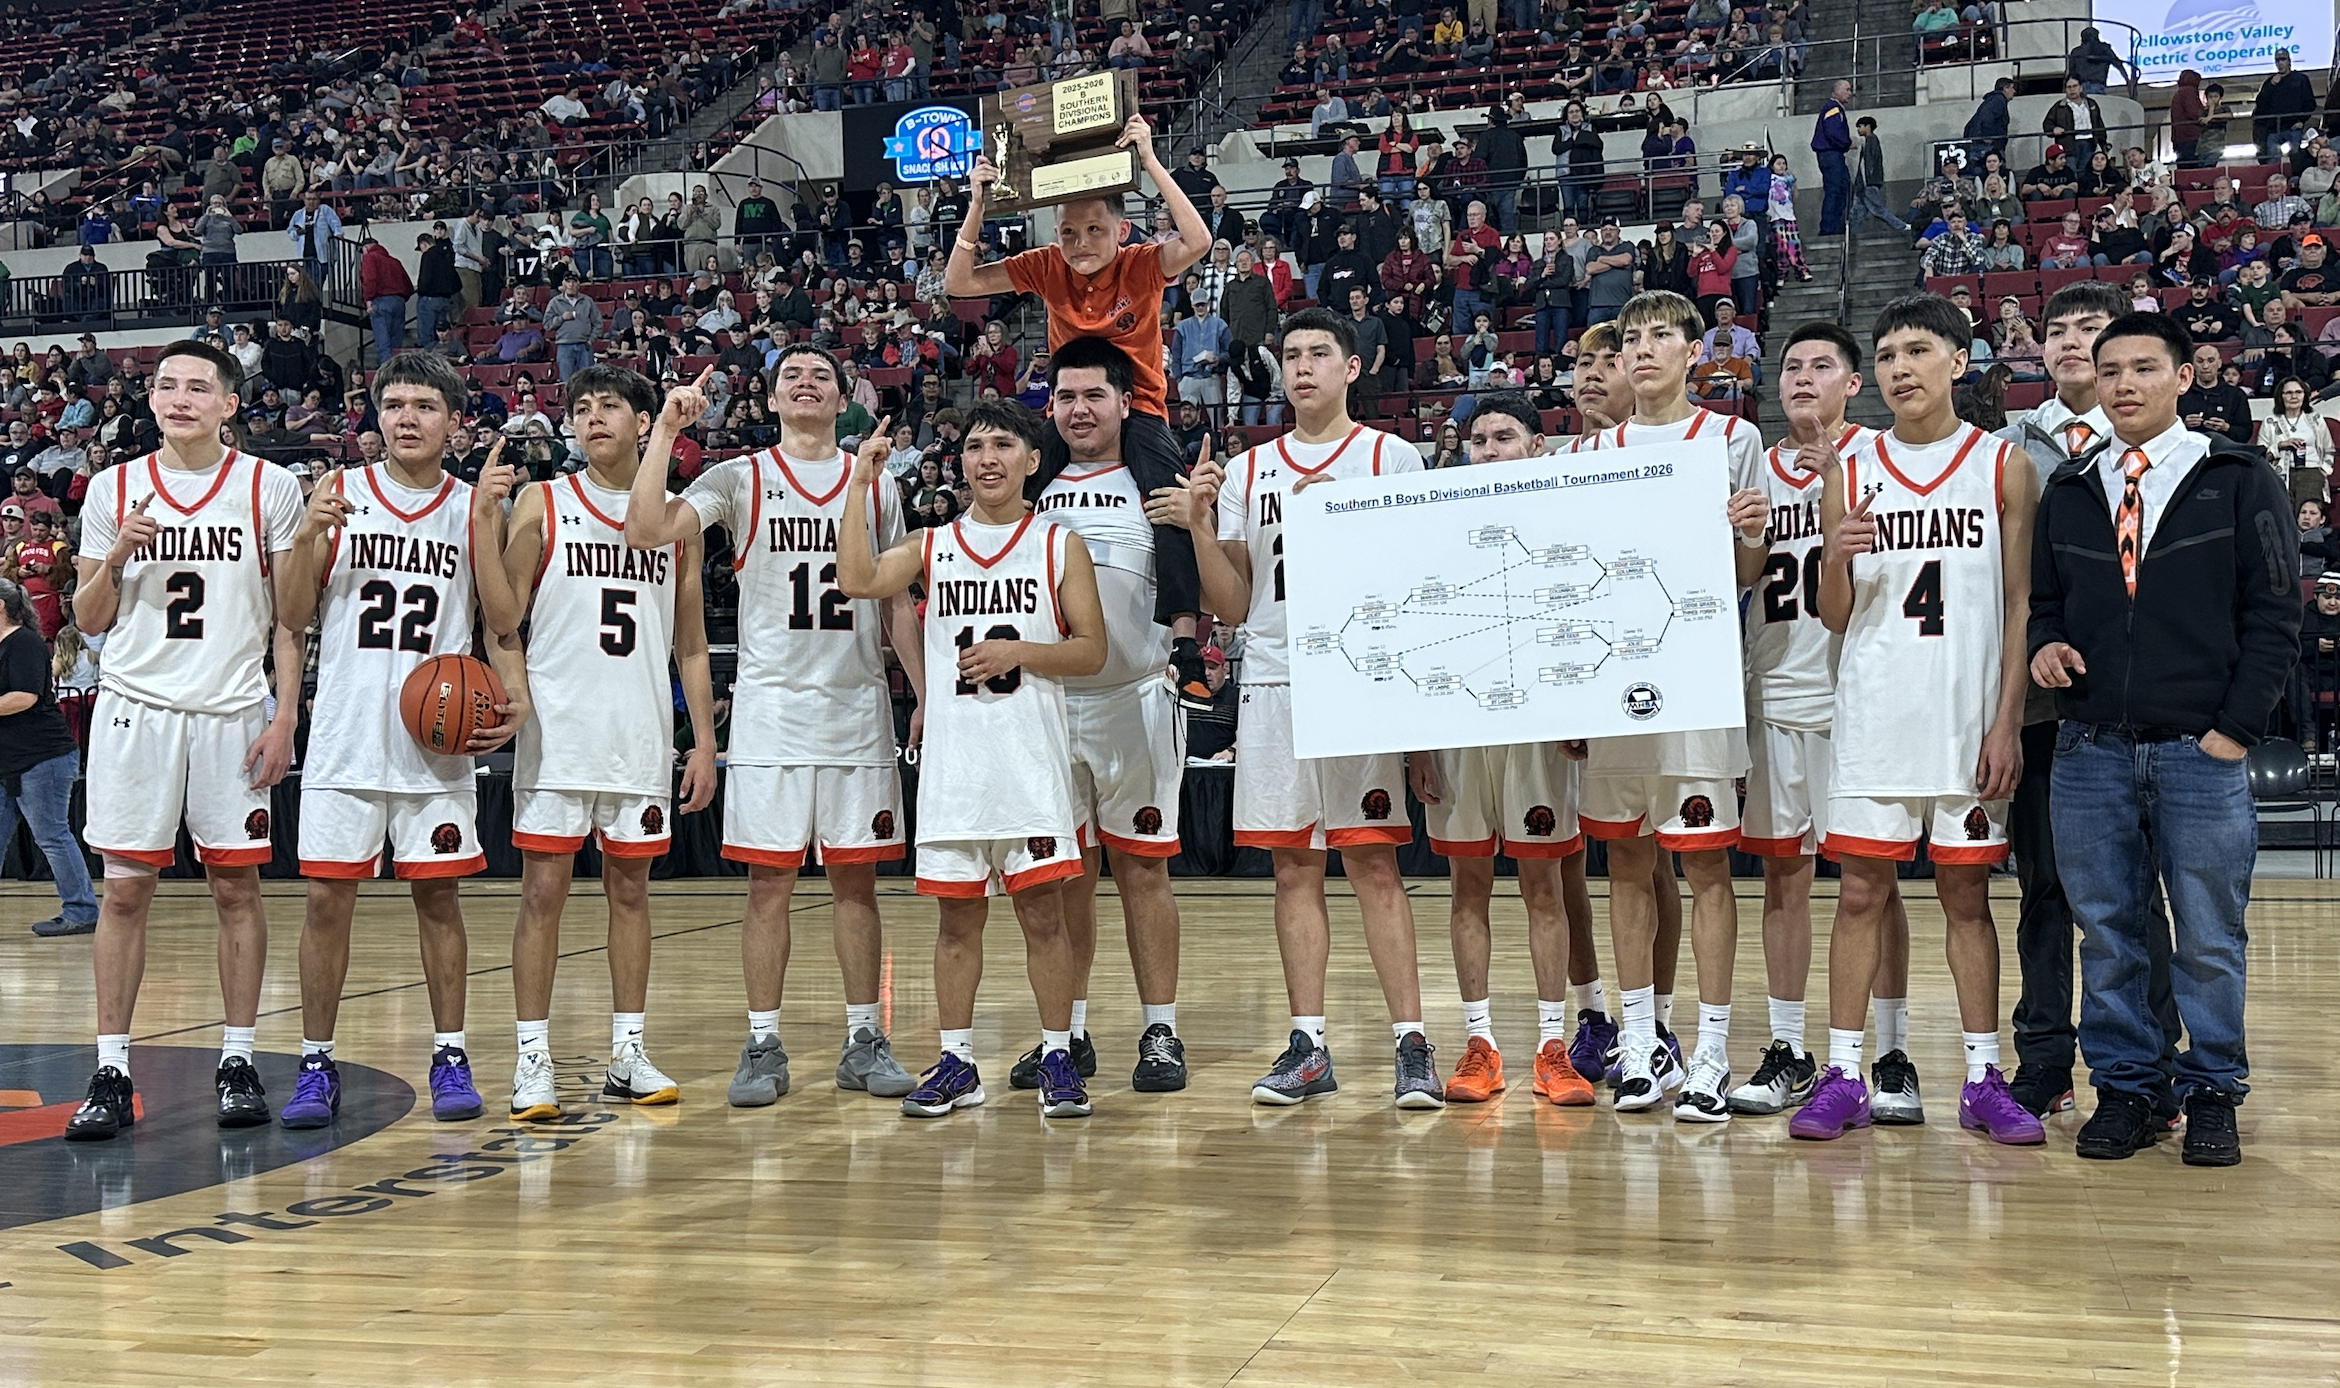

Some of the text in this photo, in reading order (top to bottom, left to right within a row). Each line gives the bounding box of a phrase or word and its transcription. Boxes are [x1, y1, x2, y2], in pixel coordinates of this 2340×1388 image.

[2240, 25, 2294, 40] Valley
[1062, 79, 1104, 94] 2025-2026
[2203, 64, 2222, 73] INC
[1058, 113, 1111, 129] CHAMPIONS
[1059, 95, 1108, 111] SOUTHERN
[1059, 105, 1109, 120] DIVISIONAL
[516, 257, 540, 276] 17
[1324, 463, 1674, 513] Southern B Boys Divisional Basketball Tournament 2026
[350, 533, 459, 580] INDIANS
[565, 542, 669, 586] INDIANS
[165, 571, 205, 639] 2
[358, 579, 440, 655] 22
[937, 578, 1038, 618] INDIANS
[1902, 559, 1945, 637] 4
[599, 587, 637, 657] 5
